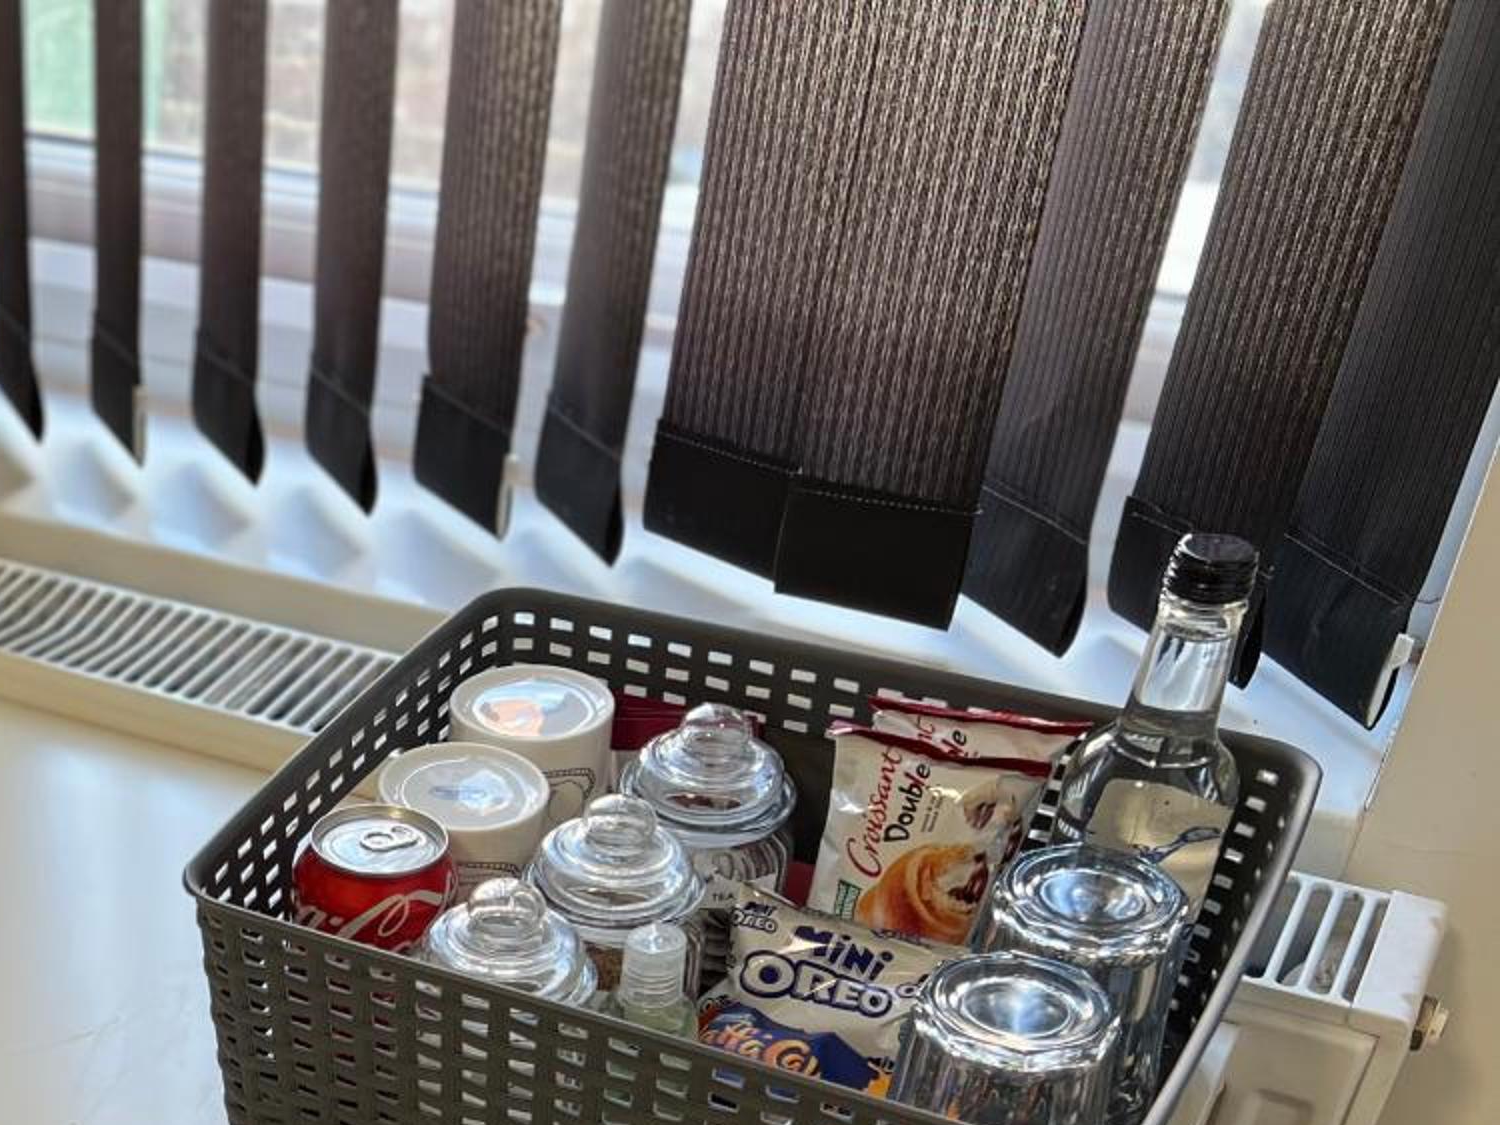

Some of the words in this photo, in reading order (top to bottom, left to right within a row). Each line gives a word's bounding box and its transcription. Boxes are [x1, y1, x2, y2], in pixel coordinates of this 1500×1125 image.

[846, 746, 903, 878] Croissant
[884, 763, 930, 843] Double
[731, 906, 778, 934] OREO
[741, 950, 892, 1018] OREO
